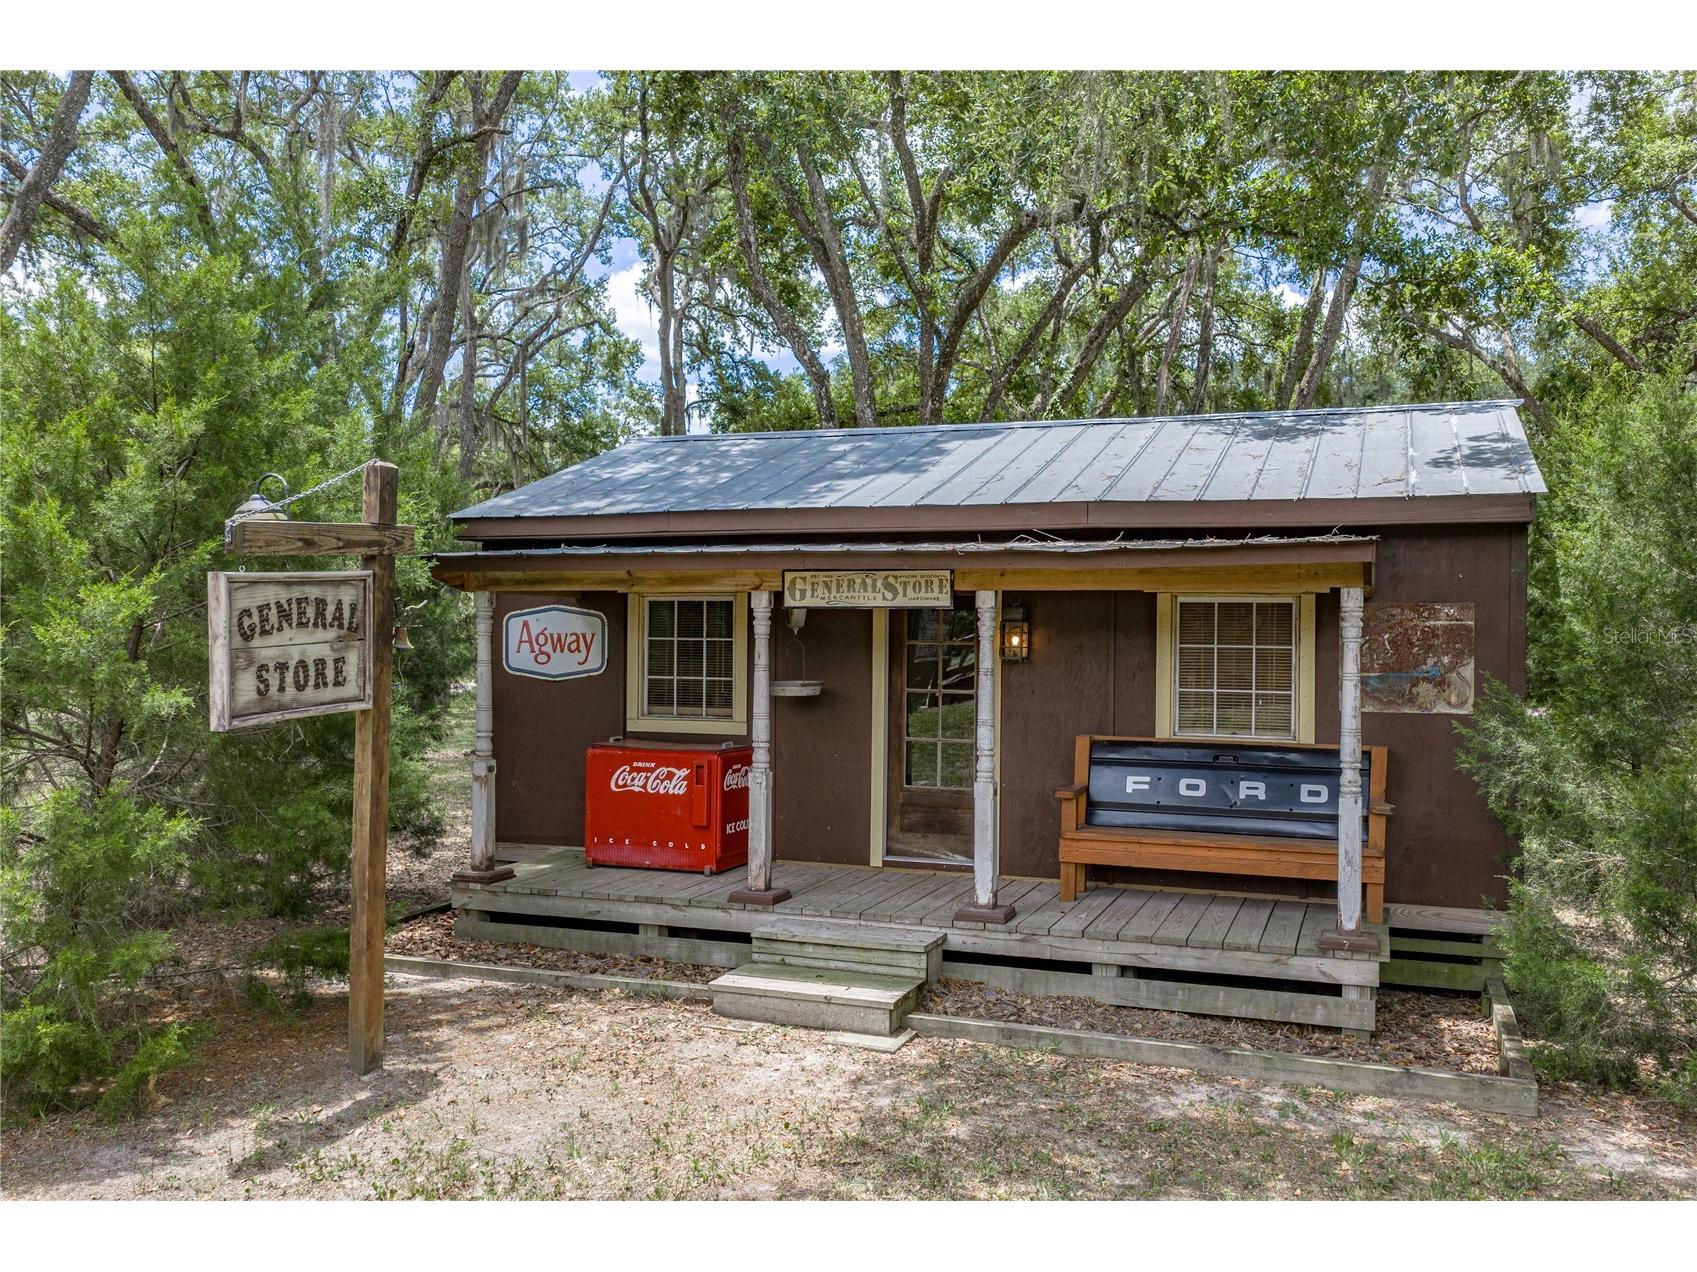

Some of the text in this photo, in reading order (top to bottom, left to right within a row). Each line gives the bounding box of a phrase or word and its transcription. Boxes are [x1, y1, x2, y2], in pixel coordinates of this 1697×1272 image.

[787, 574, 949, 602] GENERAL STORE
[236, 596, 359, 643] GENERAL
[516, 619, 597, 666] Agway
[255, 655, 347, 697] STORE
[610, 765, 691, 795] Coca-Cola
[1125, 775, 1329, 804] FORD
[594, 836, 706, 850] ICE COLD
[726, 822, 736, 835] ICE
